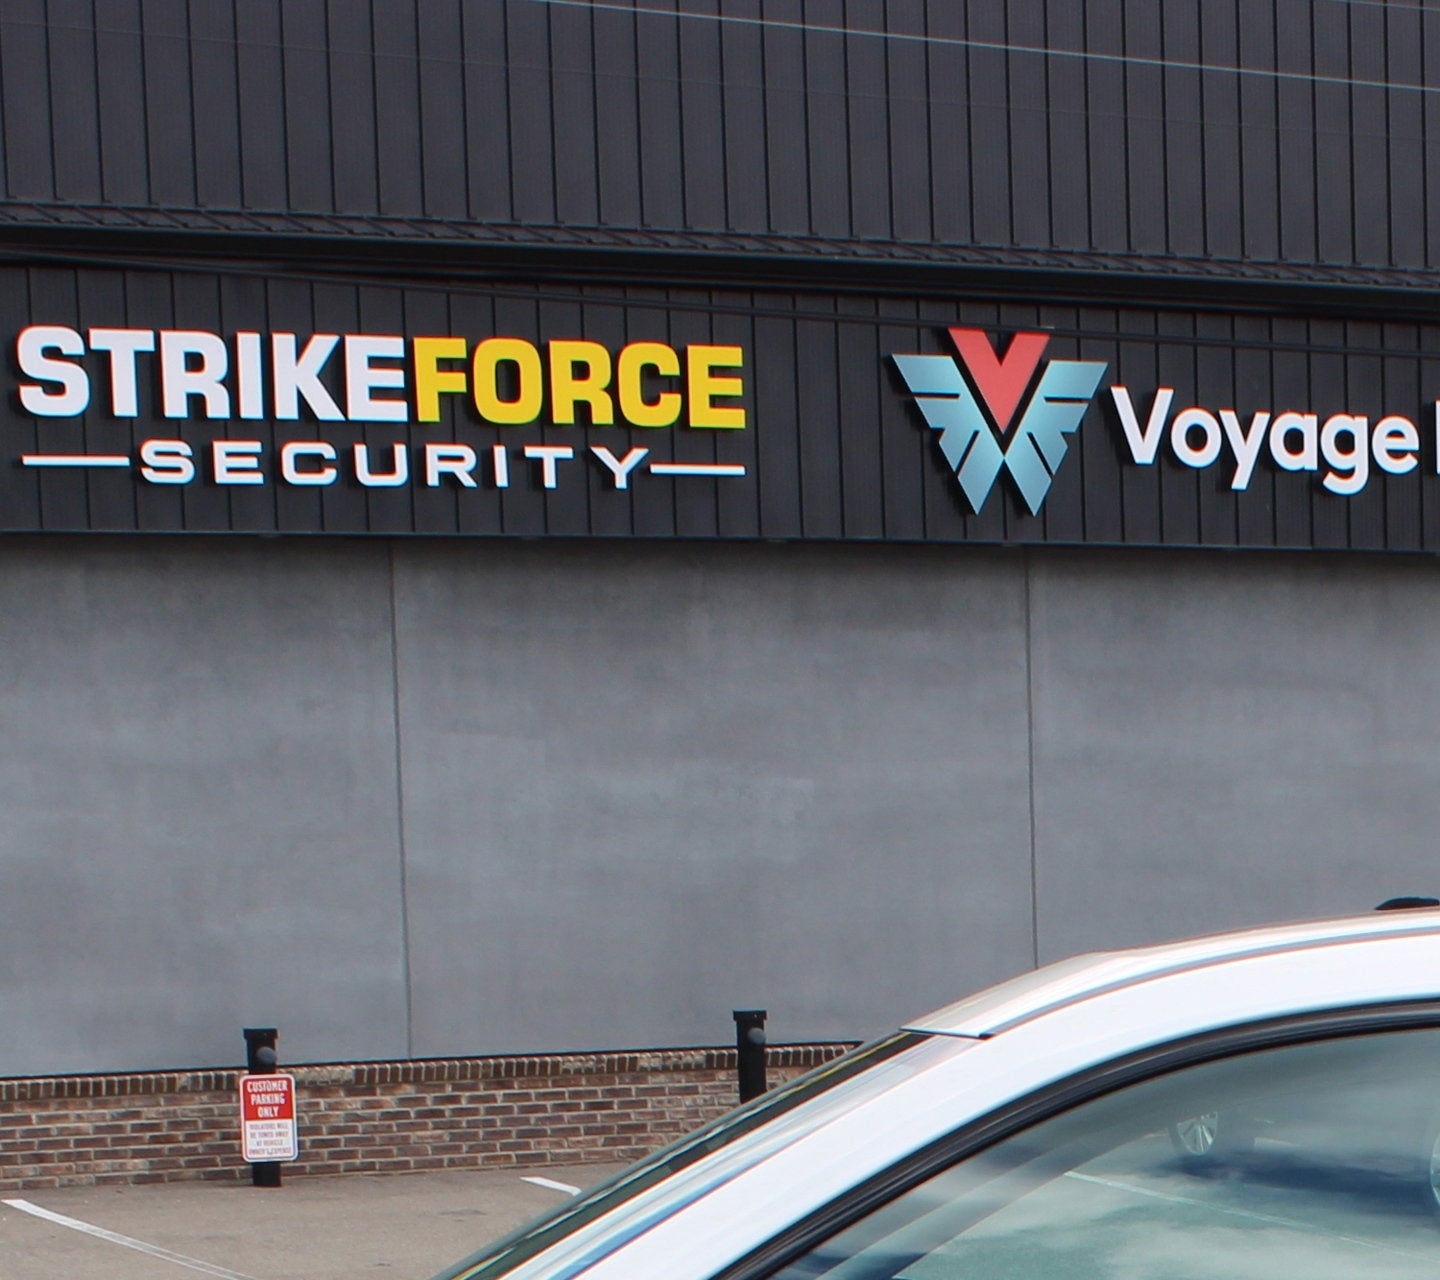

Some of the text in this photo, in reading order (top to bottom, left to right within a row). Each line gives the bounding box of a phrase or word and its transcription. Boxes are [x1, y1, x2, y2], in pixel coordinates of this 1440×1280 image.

[17, 324, 747, 429] STRIKEFORCE
[1111, 387, 1419, 495] Voyage
[141, 440, 647, 489] SECURITY
[247, 1080, 288, 1093] CUSTOMER
[250, 1093, 285, 1106] PARKING
[257, 1106, 279, 1118] ONLY
